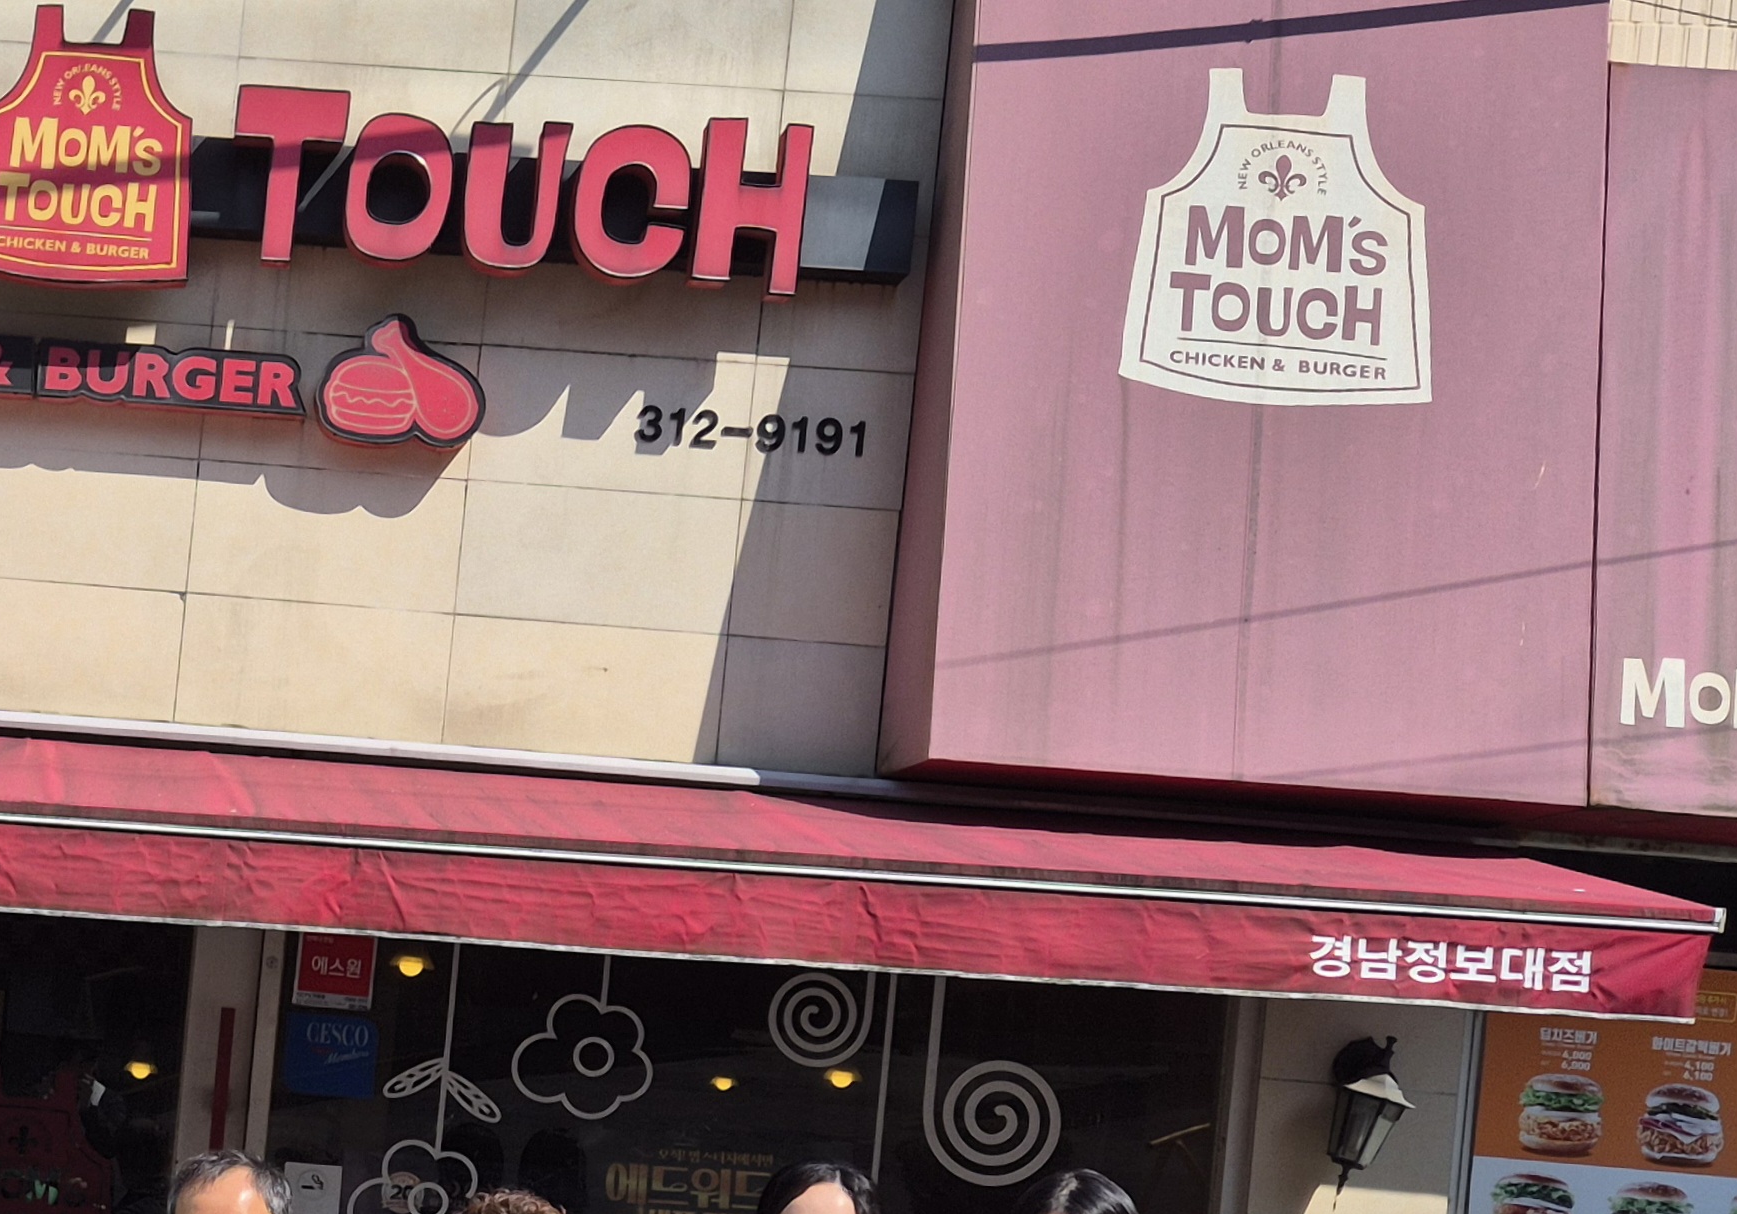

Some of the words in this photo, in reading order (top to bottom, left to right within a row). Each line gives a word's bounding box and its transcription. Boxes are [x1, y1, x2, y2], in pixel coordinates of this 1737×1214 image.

[232, 84, 815, 301] TOUCH
[1236, 158, 1253, 190] NEW
[1250, 138, 1315, 159] ORLEANS
[1311, 156, 1329, 197] STYLE
[71, 240, 83, 253] &
[86, 243, 150, 260] BURGER
[1169, 270, 1383, 347] TOUCH
[43, 347, 300, 411] BURGER
[1169, 350, 1266, 372] CHICKEN
[1271, 358, 1286, 373] &
[1298, 359, 1388, 380] BURGER
[633, 404, 869, 459] 312-9191
[311, 955, 363, 979] 에스원
[1308, 935, 1593, 993] 경남정보대점
[306, 1021, 370, 1048] CESCO
[606, 1163, 774, 1210] 에드워드
